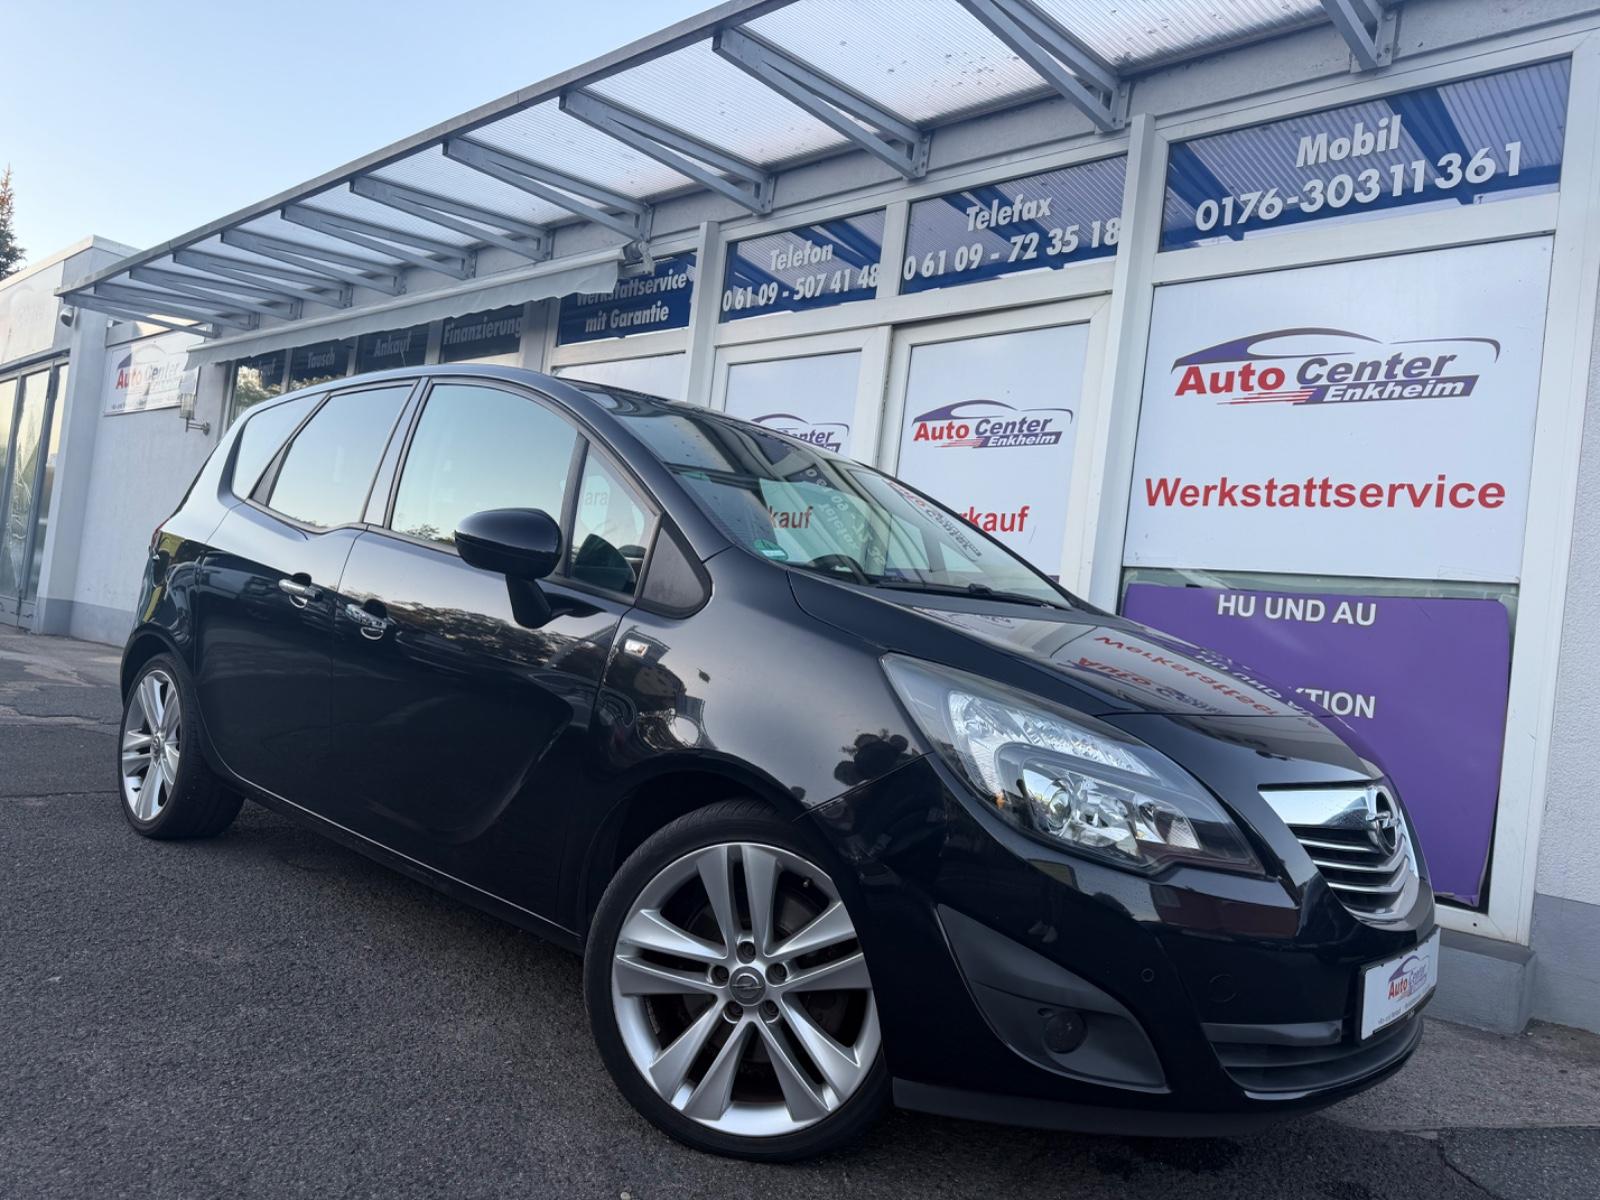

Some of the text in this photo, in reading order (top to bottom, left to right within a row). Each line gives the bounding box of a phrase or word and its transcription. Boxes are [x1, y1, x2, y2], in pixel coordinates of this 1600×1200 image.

[1296, 114, 1402, 168] Mobil
[966, 194, 1052, 232] Telefax
[770, 240, 833, 271] Telefon
[903, 257, 916, 281] 0
[921, 251, 946, 278] 61
[952, 243, 985, 272] 09
[1008, 233, 1038, 263] 72
[1046, 224, 1080, 256] 35
[1091, 217, 1120, 250] 18
[758, 281, 779, 306] 09
[793, 274, 824, 302] 507
[831, 269, 850, 294] 41
[443, 315, 522, 345] Finanzierung
[585, 300, 670, 333] mit Garantie
[307, 346, 336, 369] Tausch
[374, 331, 412, 358] Ankauf
[1174, 352, 1458, 397] Auto Center
[1322, 377, 1465, 402] Enkheim
[912, 416, 1053, 443] Auto Center
[987, 434, 1056, 448] Enkheim
[1145, 474, 1506, 509] Werkstattservice
[1216, 594, 1377, 626] HU UND AU
[1294, 686, 1377, 719] TION
[1387, 977, 1408, 1001] Auto
